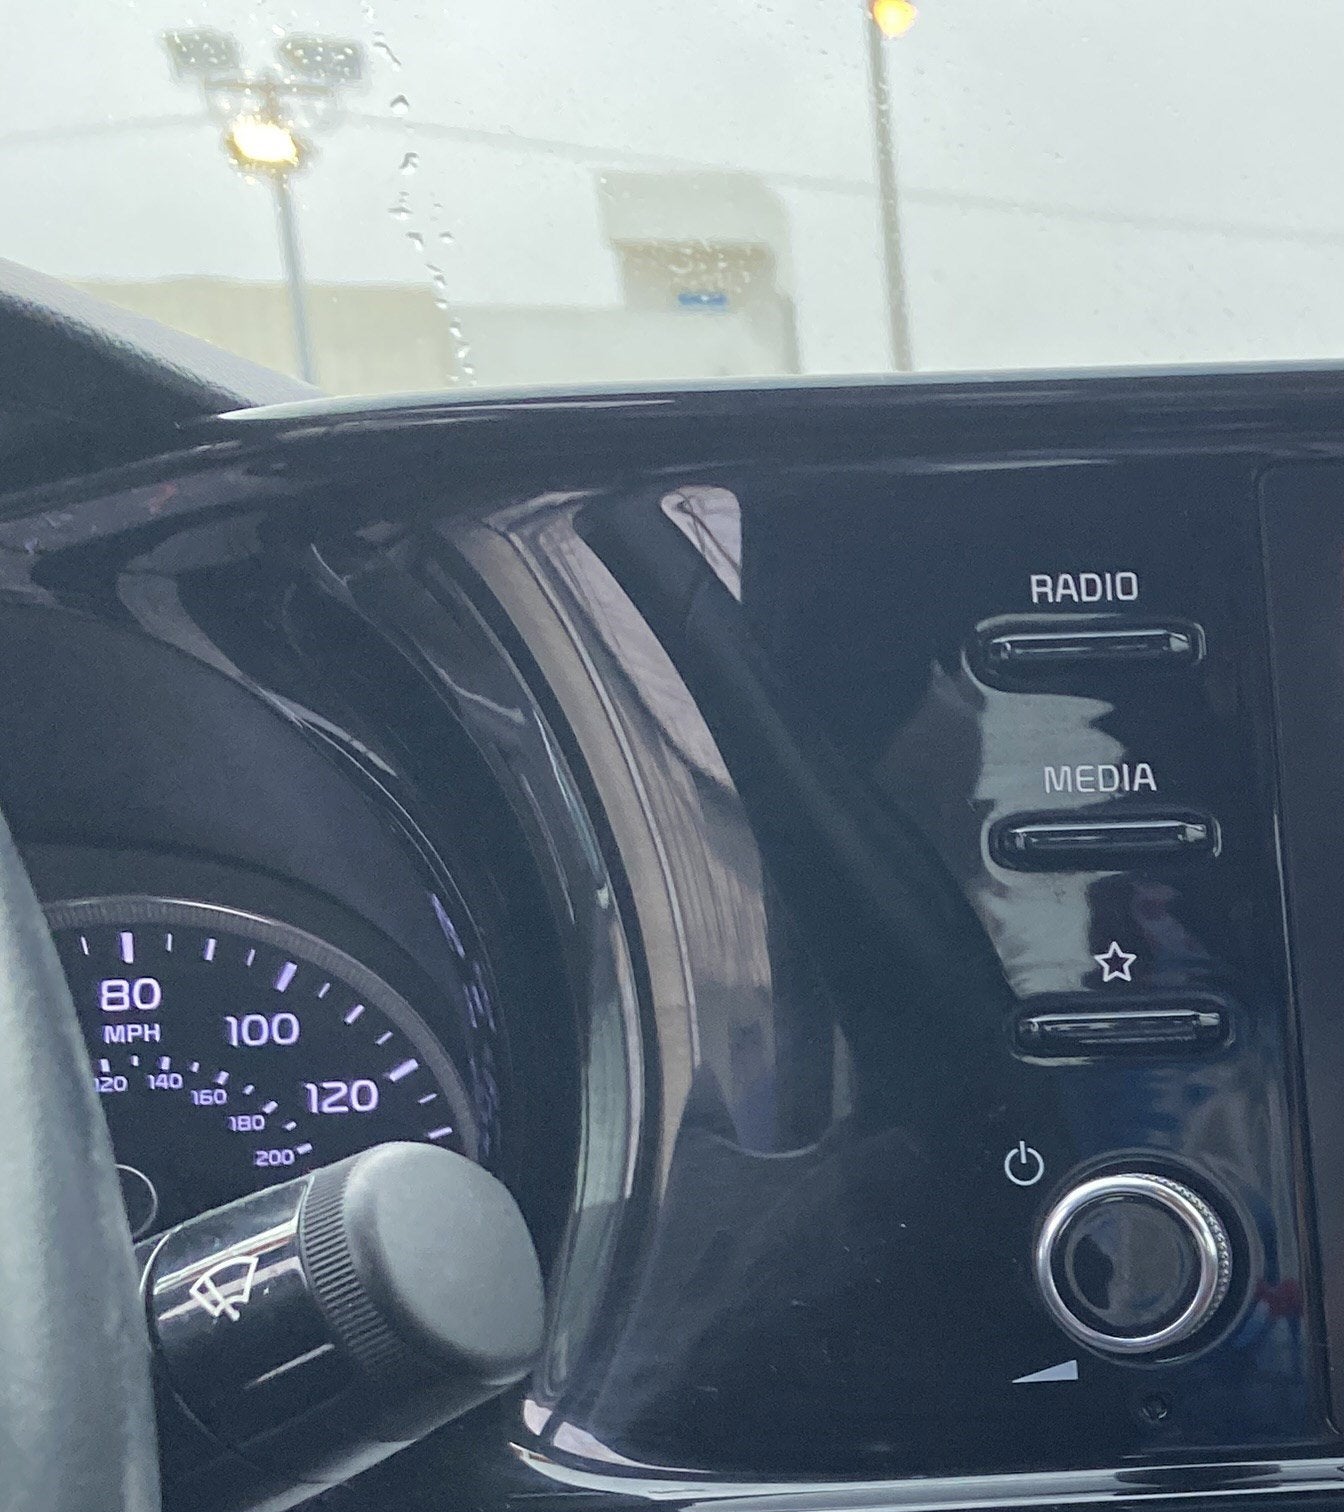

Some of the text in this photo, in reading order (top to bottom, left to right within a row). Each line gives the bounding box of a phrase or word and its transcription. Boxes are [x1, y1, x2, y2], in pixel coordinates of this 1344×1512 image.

[1029, 570, 1140, 604] RADIO
[1042, 762, 1157, 795] MEDIA
[100, 977, 162, 1012] 80
[103, 1022, 161, 1044] MPH
[225, 1011, 300, 1047] 100
[147, 1073, 183, 1091] 140
[191, 1088, 227, 1106] 160
[305, 1079, 379, 1114] 120
[228, 1113, 266, 1133] 180
[254, 1149, 296, 1167] 200
